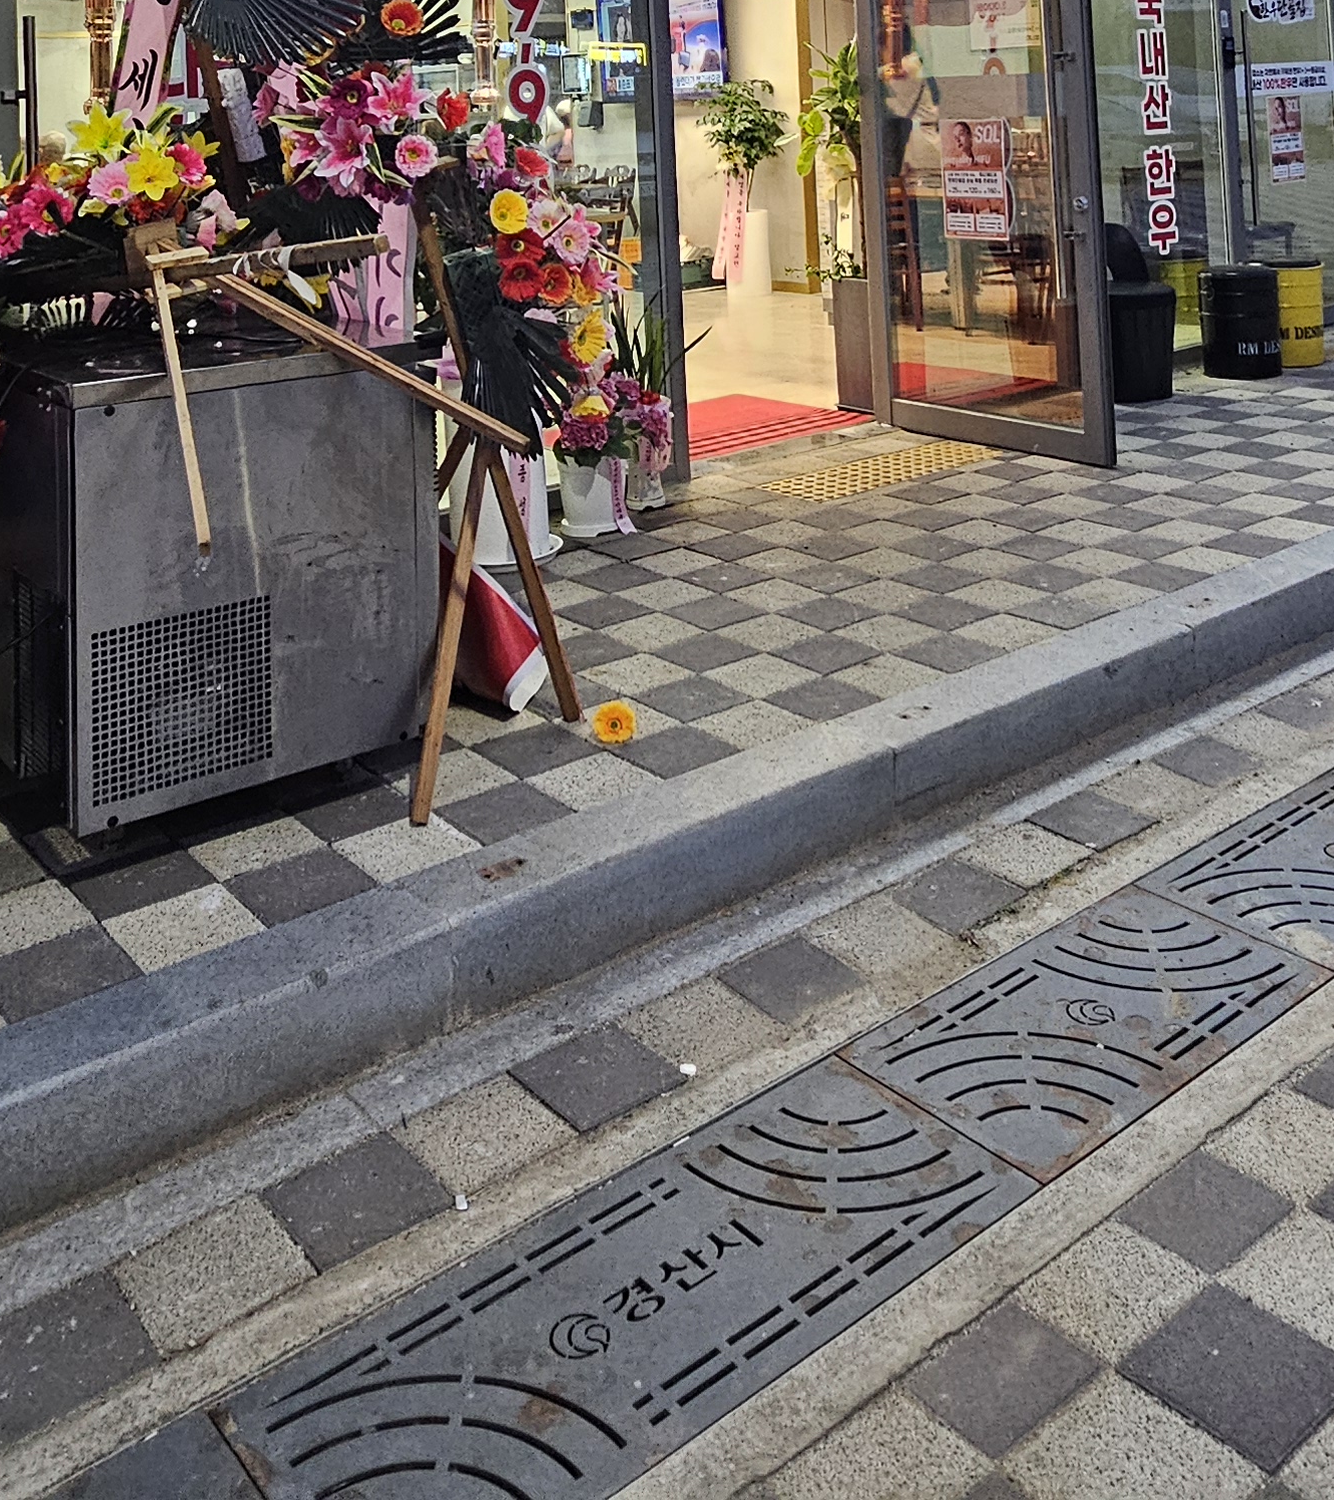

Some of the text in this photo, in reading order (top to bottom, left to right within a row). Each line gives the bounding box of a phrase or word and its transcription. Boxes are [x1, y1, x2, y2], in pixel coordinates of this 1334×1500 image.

[1146, 149, 1176, 251] 한우
[1238, 342, 1259, 356] RM
[603, 1219, 764, 1321] 경산시
